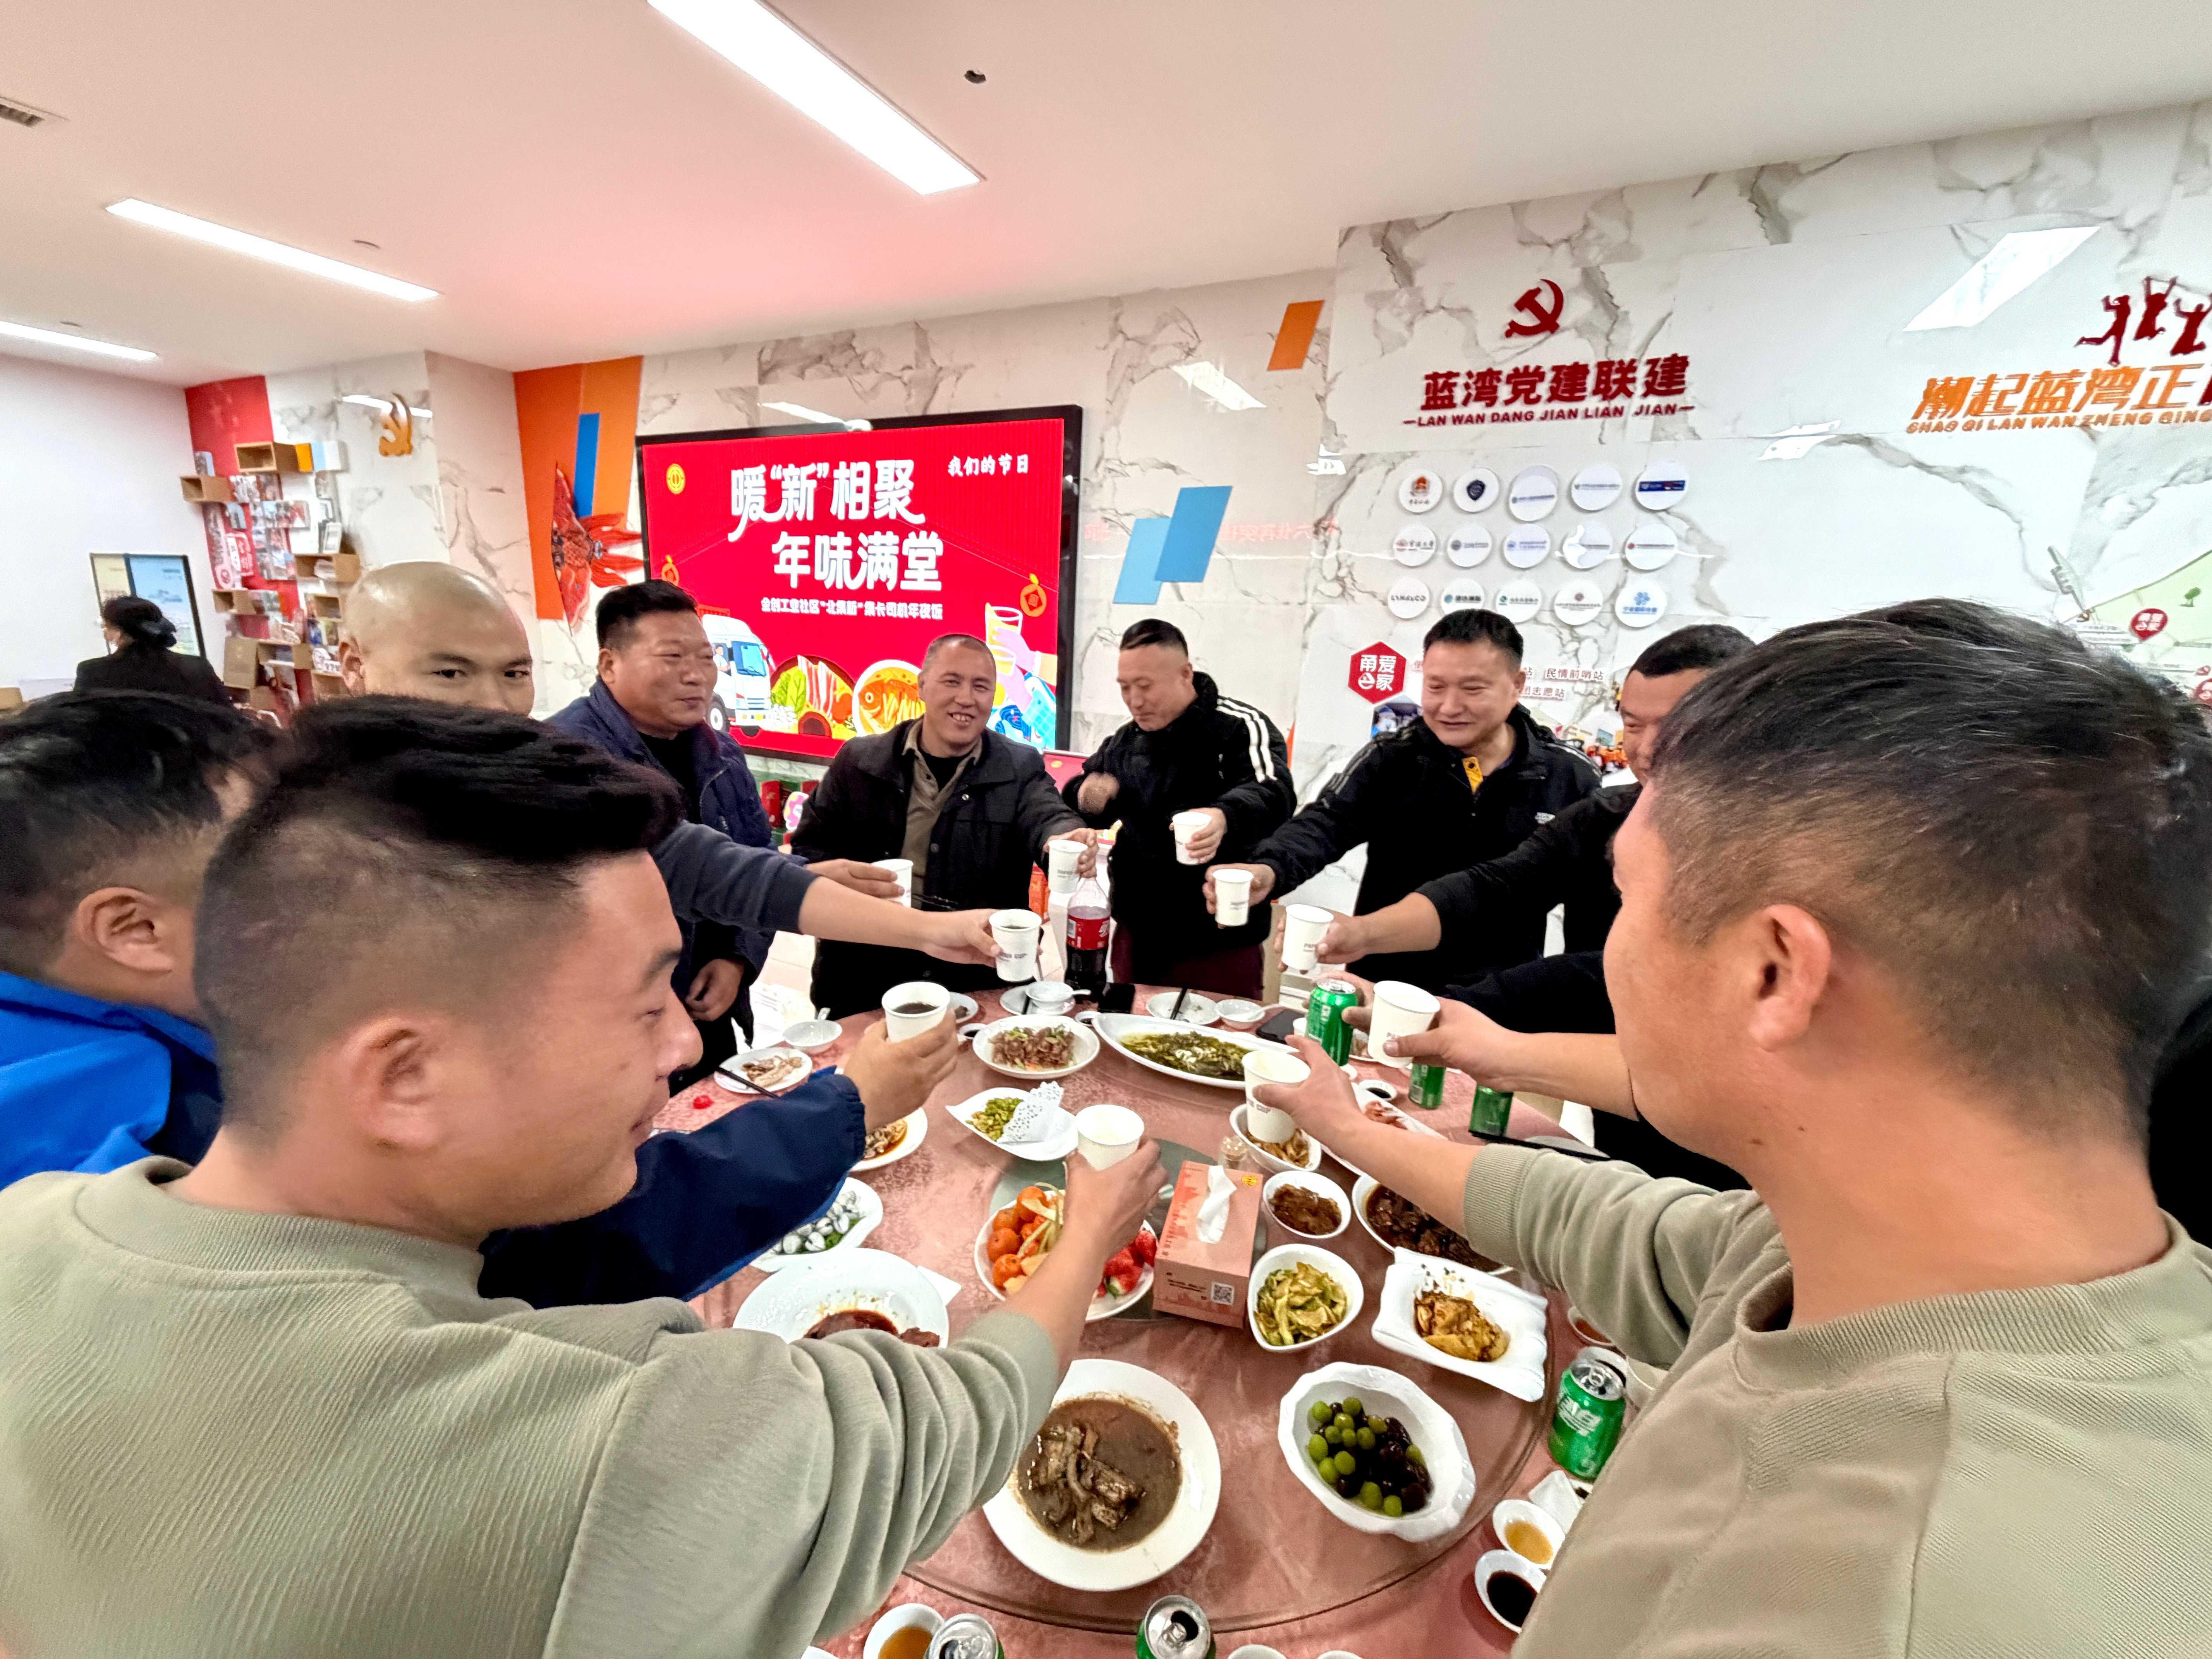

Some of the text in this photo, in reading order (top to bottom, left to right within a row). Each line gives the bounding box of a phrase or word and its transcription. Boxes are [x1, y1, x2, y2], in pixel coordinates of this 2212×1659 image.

[1420, 353, 1689, 411] 蓝湾党建联建
[1911, 363, 2212, 420] 潮起蓝湾正
[1417, 404, 1676, 426] LAN WAN DANG JIAN LIAN JIAN
[1906, 409, 2212, 434] CHAO QI LAN WAN ZHENG QING
[948, 453, 1029, 477] 我们的节日
[771, 530, 944, 591] 年味满堂
[1360, 654, 1396, 673] 甬爱
